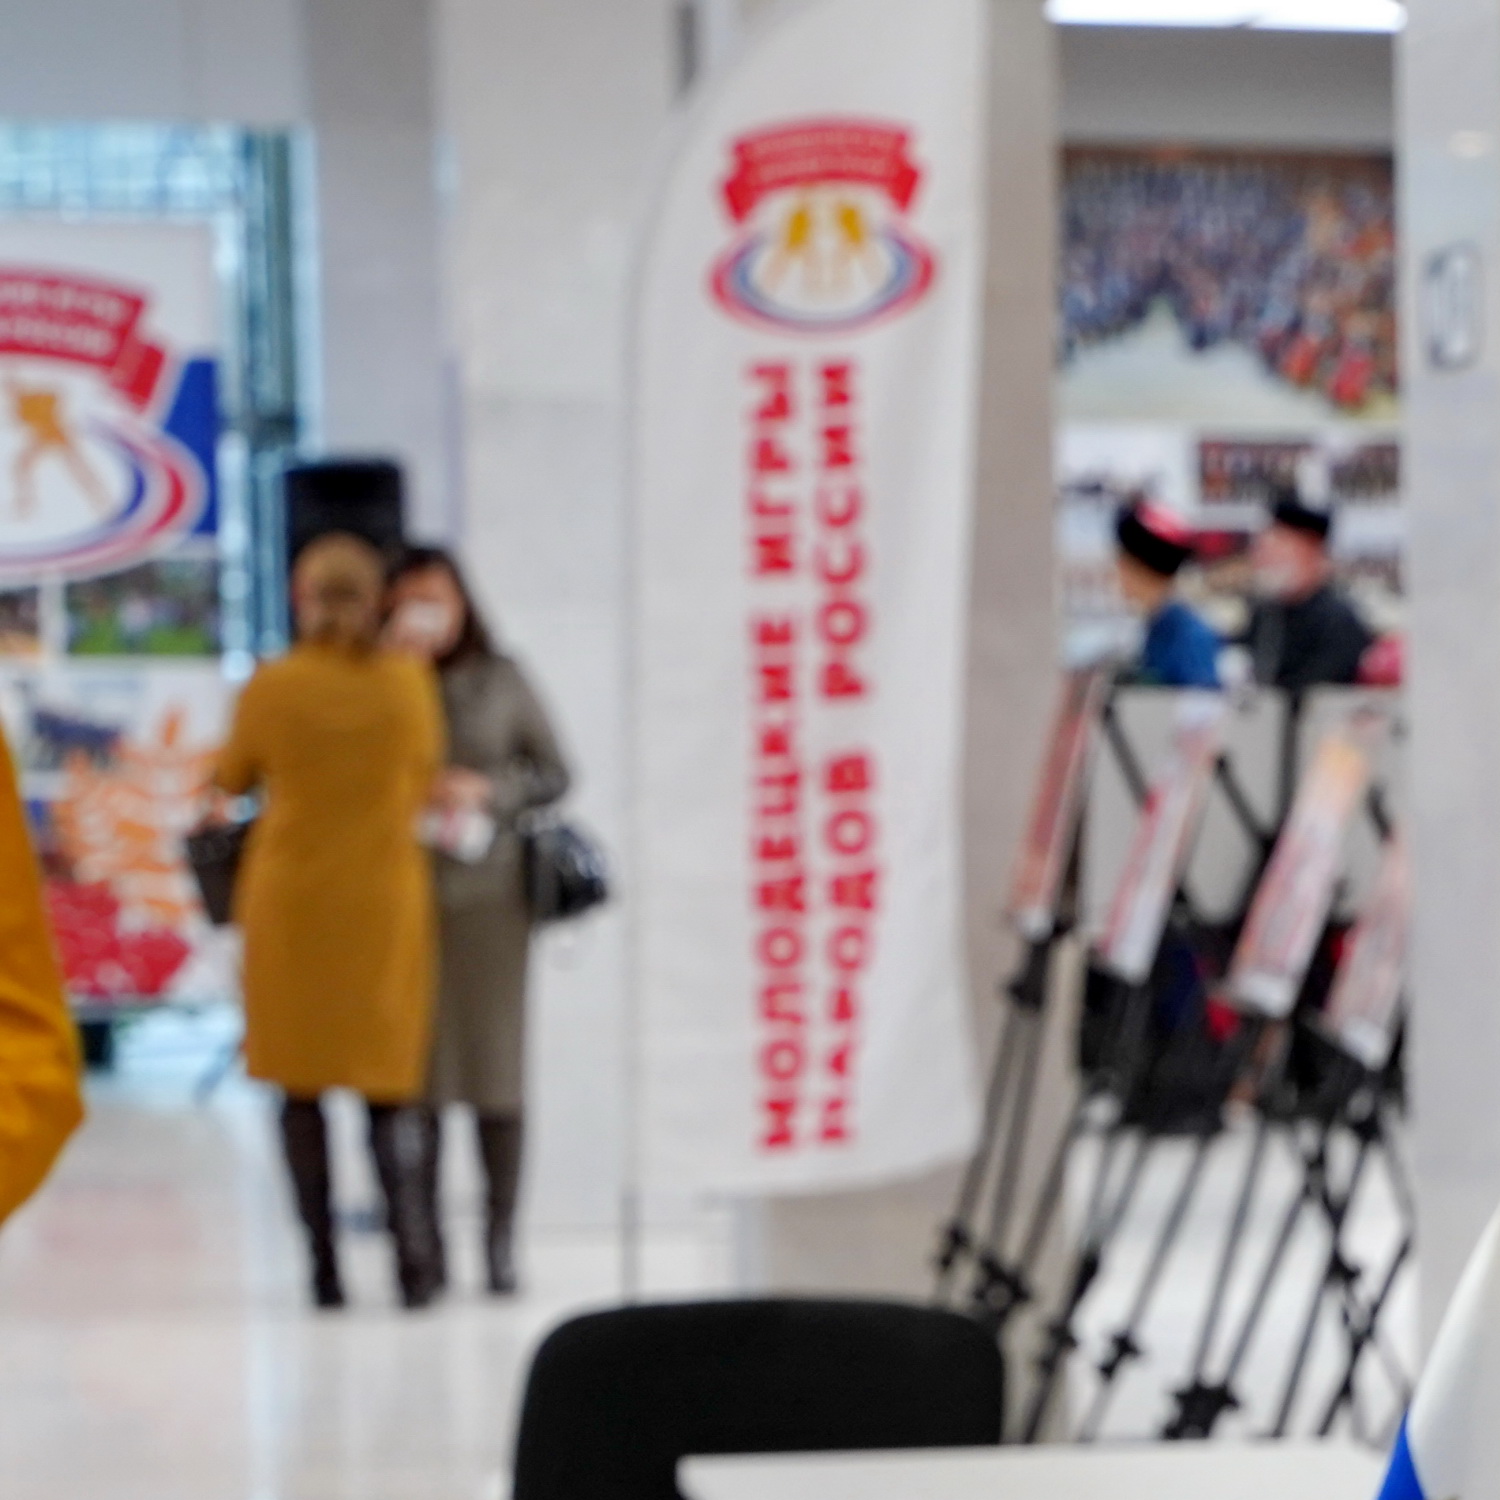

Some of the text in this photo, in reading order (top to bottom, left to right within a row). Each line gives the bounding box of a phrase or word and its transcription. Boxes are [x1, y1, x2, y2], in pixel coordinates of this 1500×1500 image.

[753, 365, 805, 1146] МОЛОДЕЦКИЕ ИГРЫ
[817, 365, 865, 699] РОССИИ
